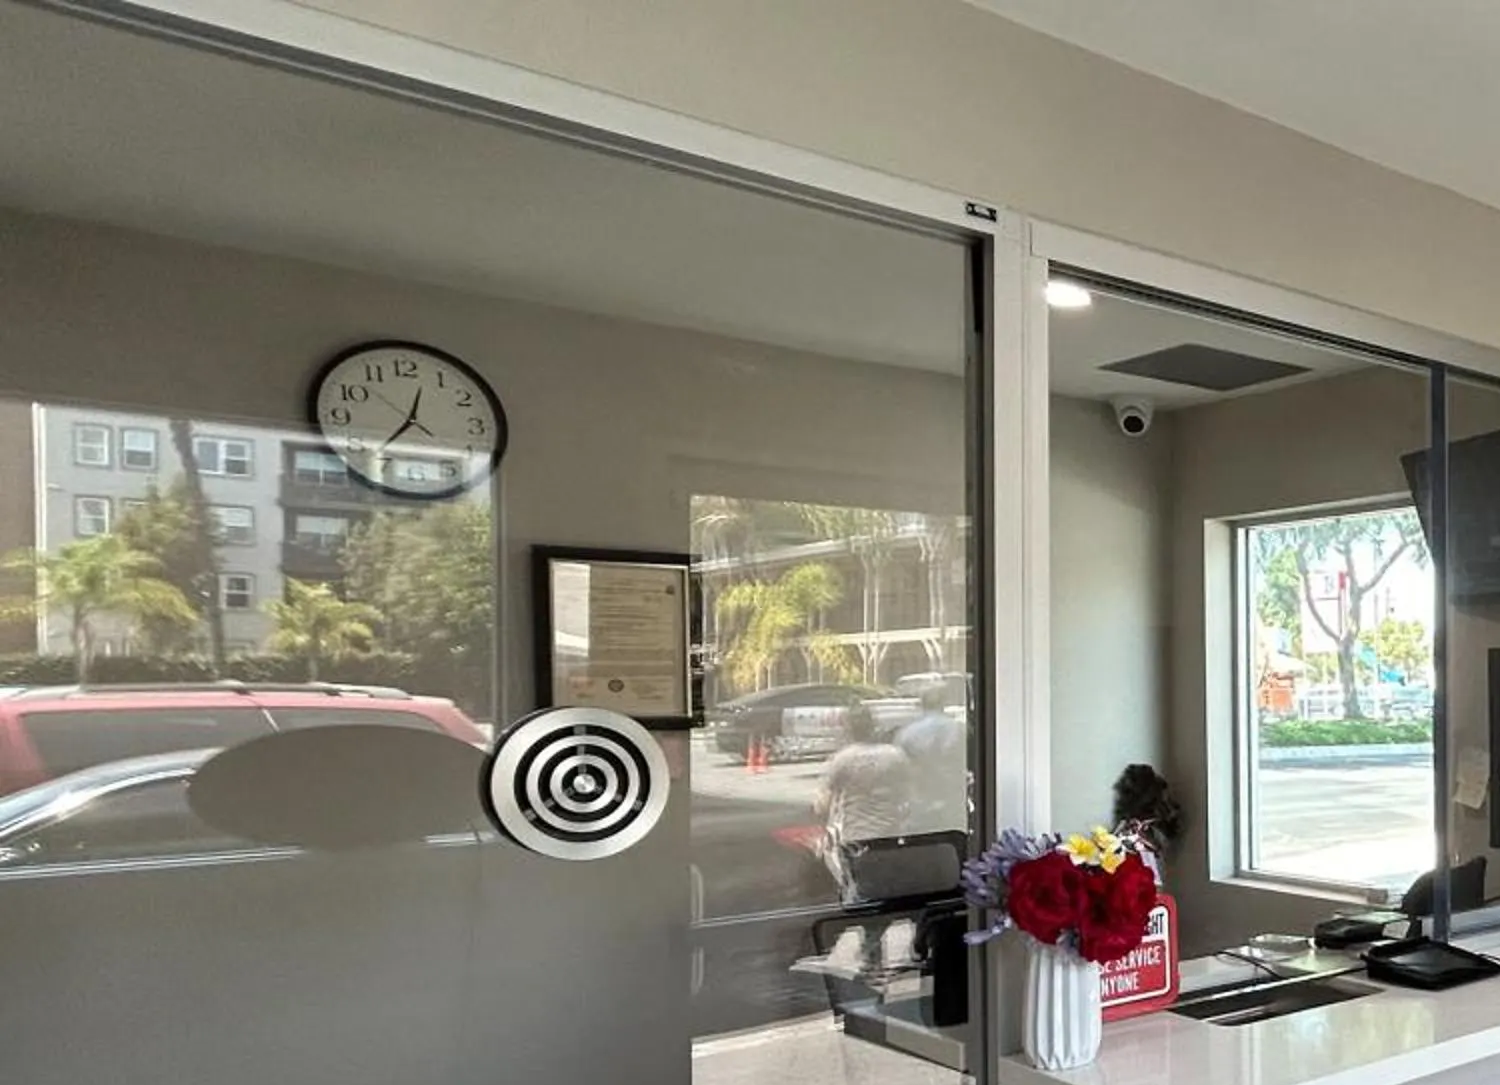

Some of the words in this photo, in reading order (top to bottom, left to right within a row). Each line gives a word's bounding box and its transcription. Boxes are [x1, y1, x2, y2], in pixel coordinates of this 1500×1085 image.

[365, 364, 384, 383] 11
[393, 358, 419, 379] 12
[437, 370, 445, 388] 1
[340, 383, 369, 403] 10
[455, 388, 472, 407] 2
[331, 406, 352, 426] 9
[467, 416, 485, 436] 3
[1101, 971, 1139, 997] NYONE
